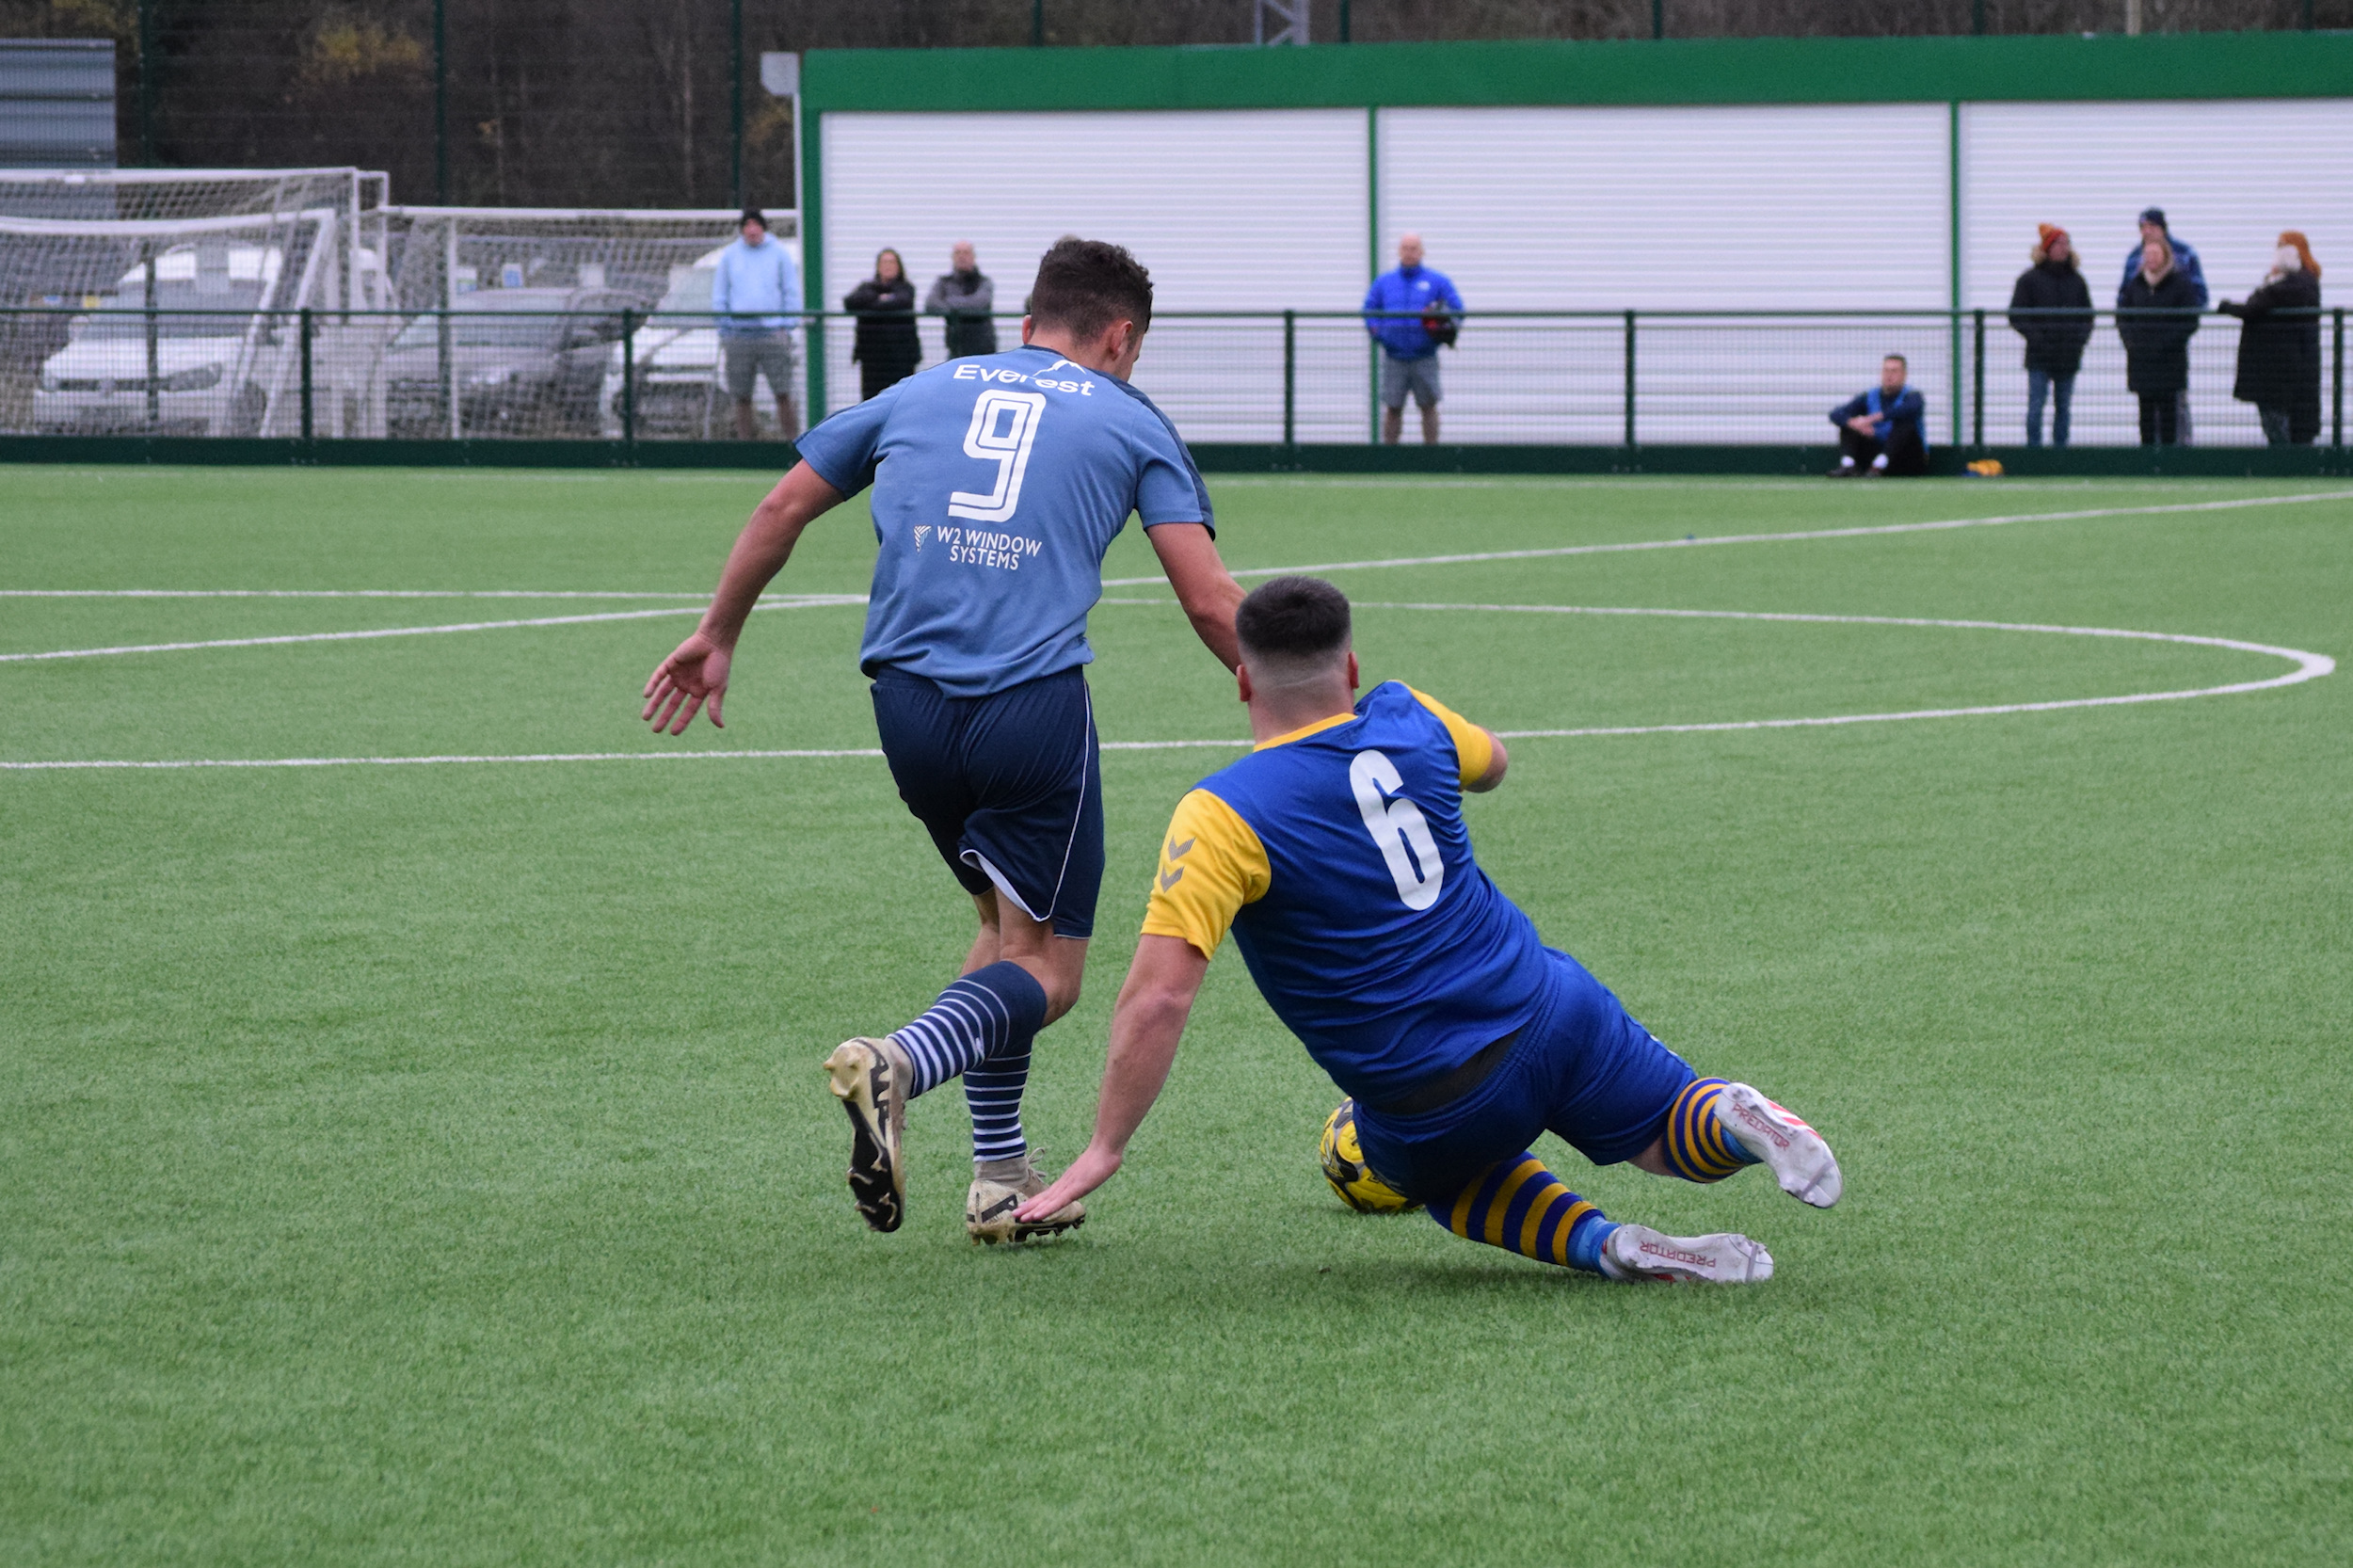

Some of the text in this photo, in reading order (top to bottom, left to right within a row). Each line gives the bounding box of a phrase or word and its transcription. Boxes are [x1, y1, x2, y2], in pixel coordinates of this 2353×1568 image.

[953, 363, 1095, 396] Everest
[948, 389, 1047, 522] 9
[937, 525, 1042, 557] W2 WINDOW
[949, 545, 1019, 570] SYSTEMS
[1350, 749, 1445, 911] 6
[1732, 1102, 1790, 1151] PREDATOR
[1640, 1240, 1717, 1268] PREDATOR
